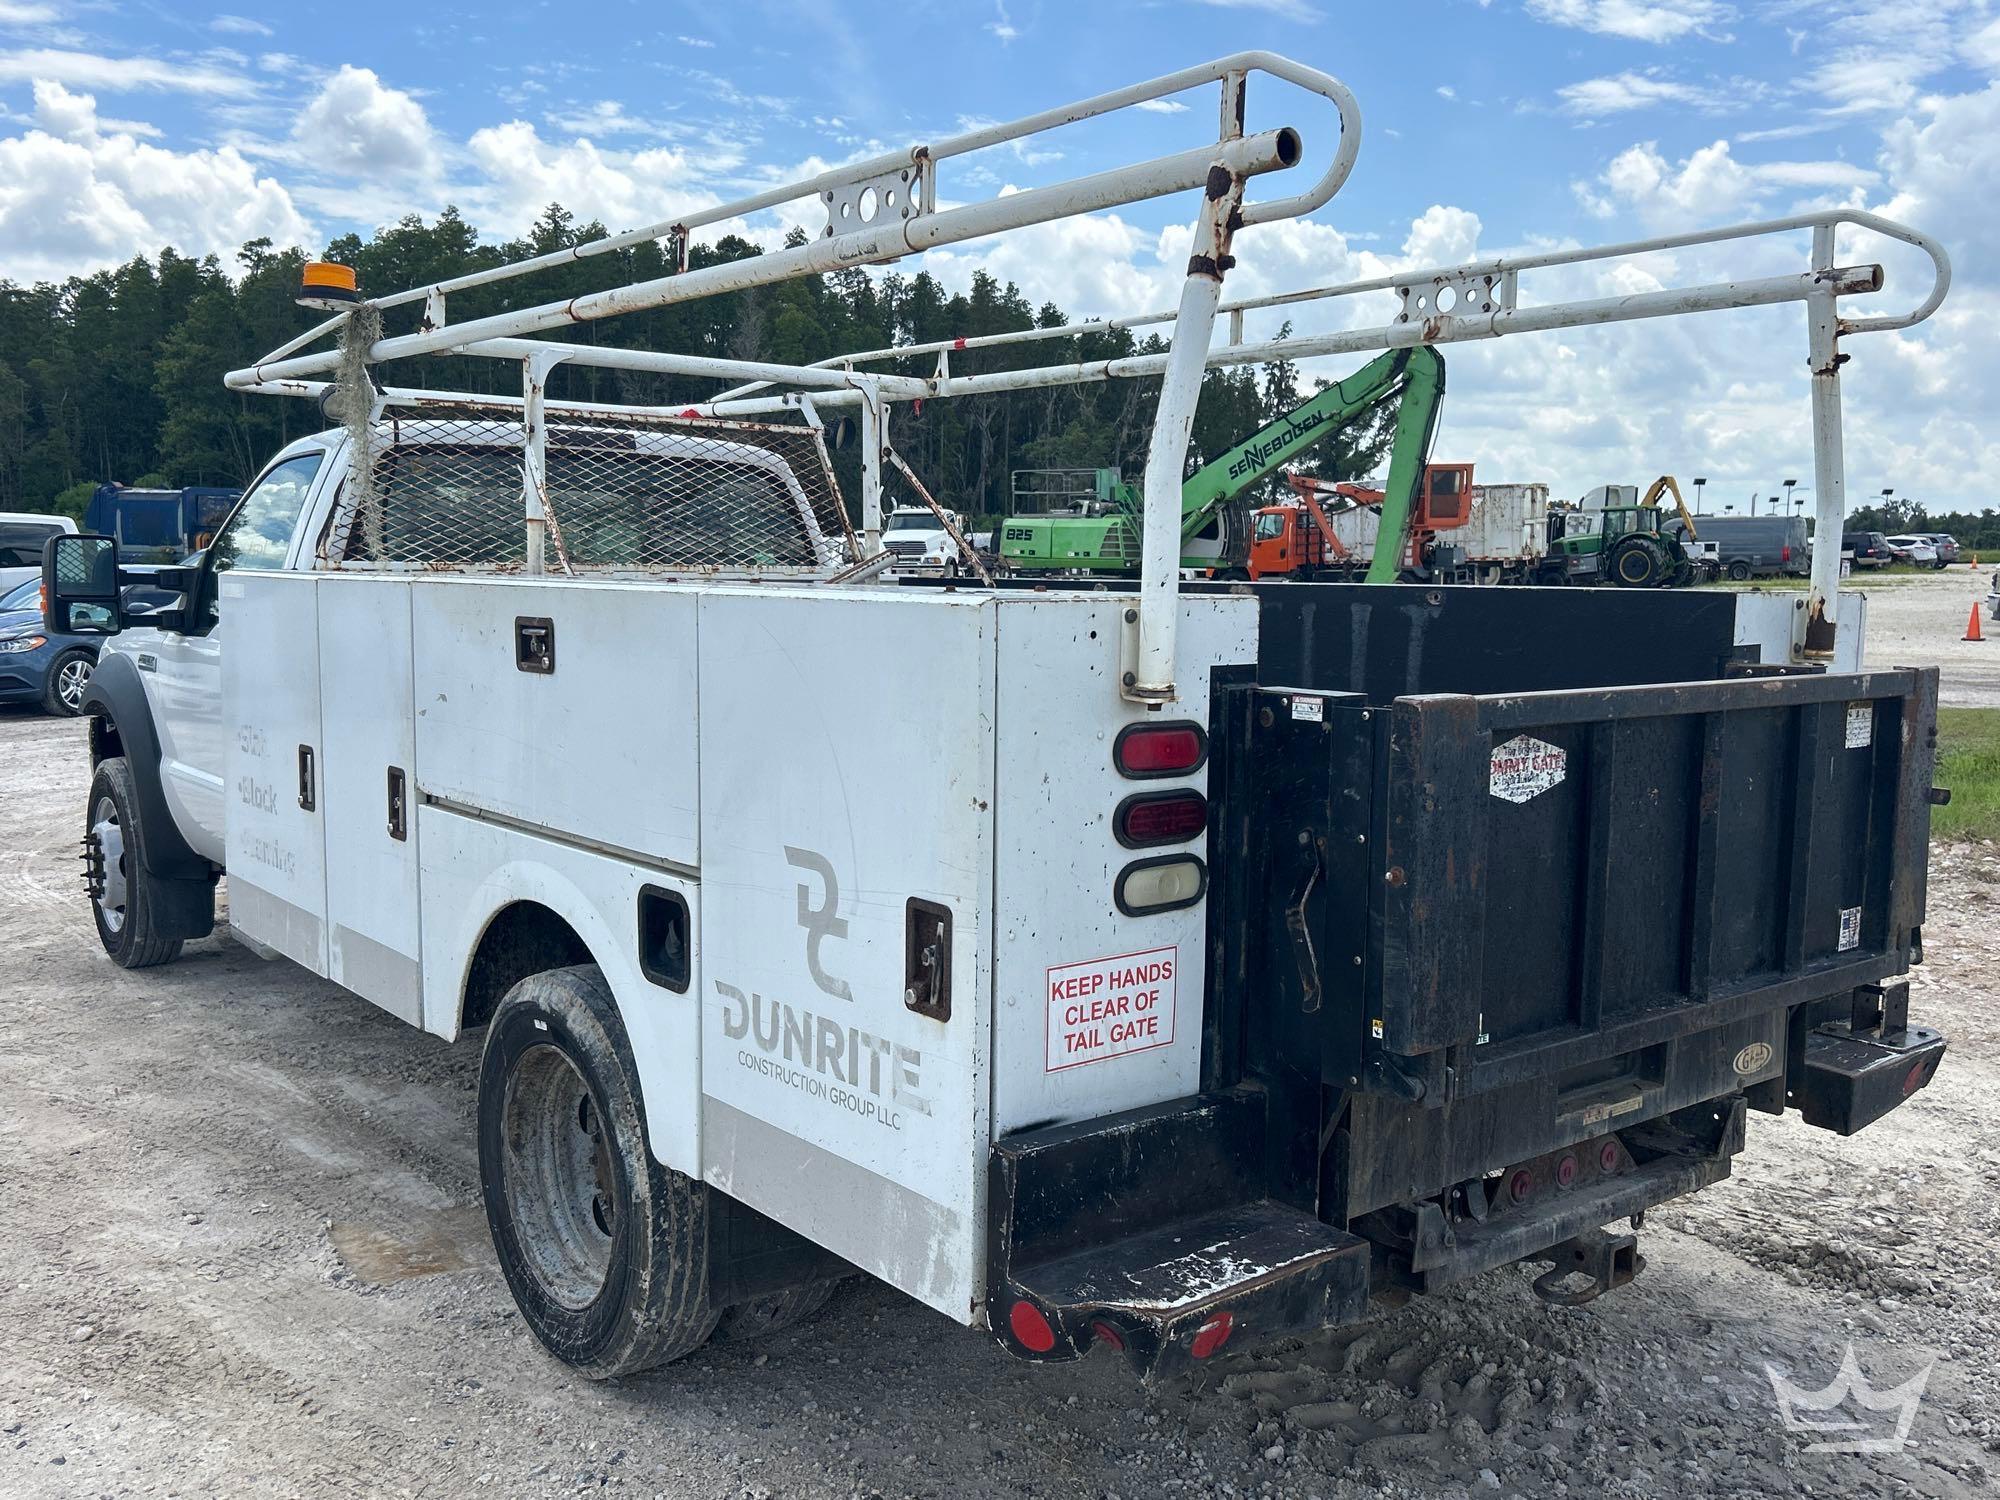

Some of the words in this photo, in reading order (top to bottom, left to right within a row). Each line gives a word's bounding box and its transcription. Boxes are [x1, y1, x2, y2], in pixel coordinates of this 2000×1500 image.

[1228, 409, 1324, 480] SENNEBOGEN
[1006, 528, 1033, 541] 825
[1051, 974, 1103, 1002] KEEP
[1109, 960, 1173, 990] HANDS
[1065, 996, 1129, 1026] CLEAR
[1134, 989, 1160, 1012] OF
[714, 979, 933, 1118] DUNRITE
[1064, 1028, 1104, 1053] TAIL
[1109, 1015, 1158, 1043] GATE
[738, 1050, 827, 1101] CONSTRUCTION
[829, 1086, 876, 1118] GROUP
[877, 1107, 901, 1131] LLC
